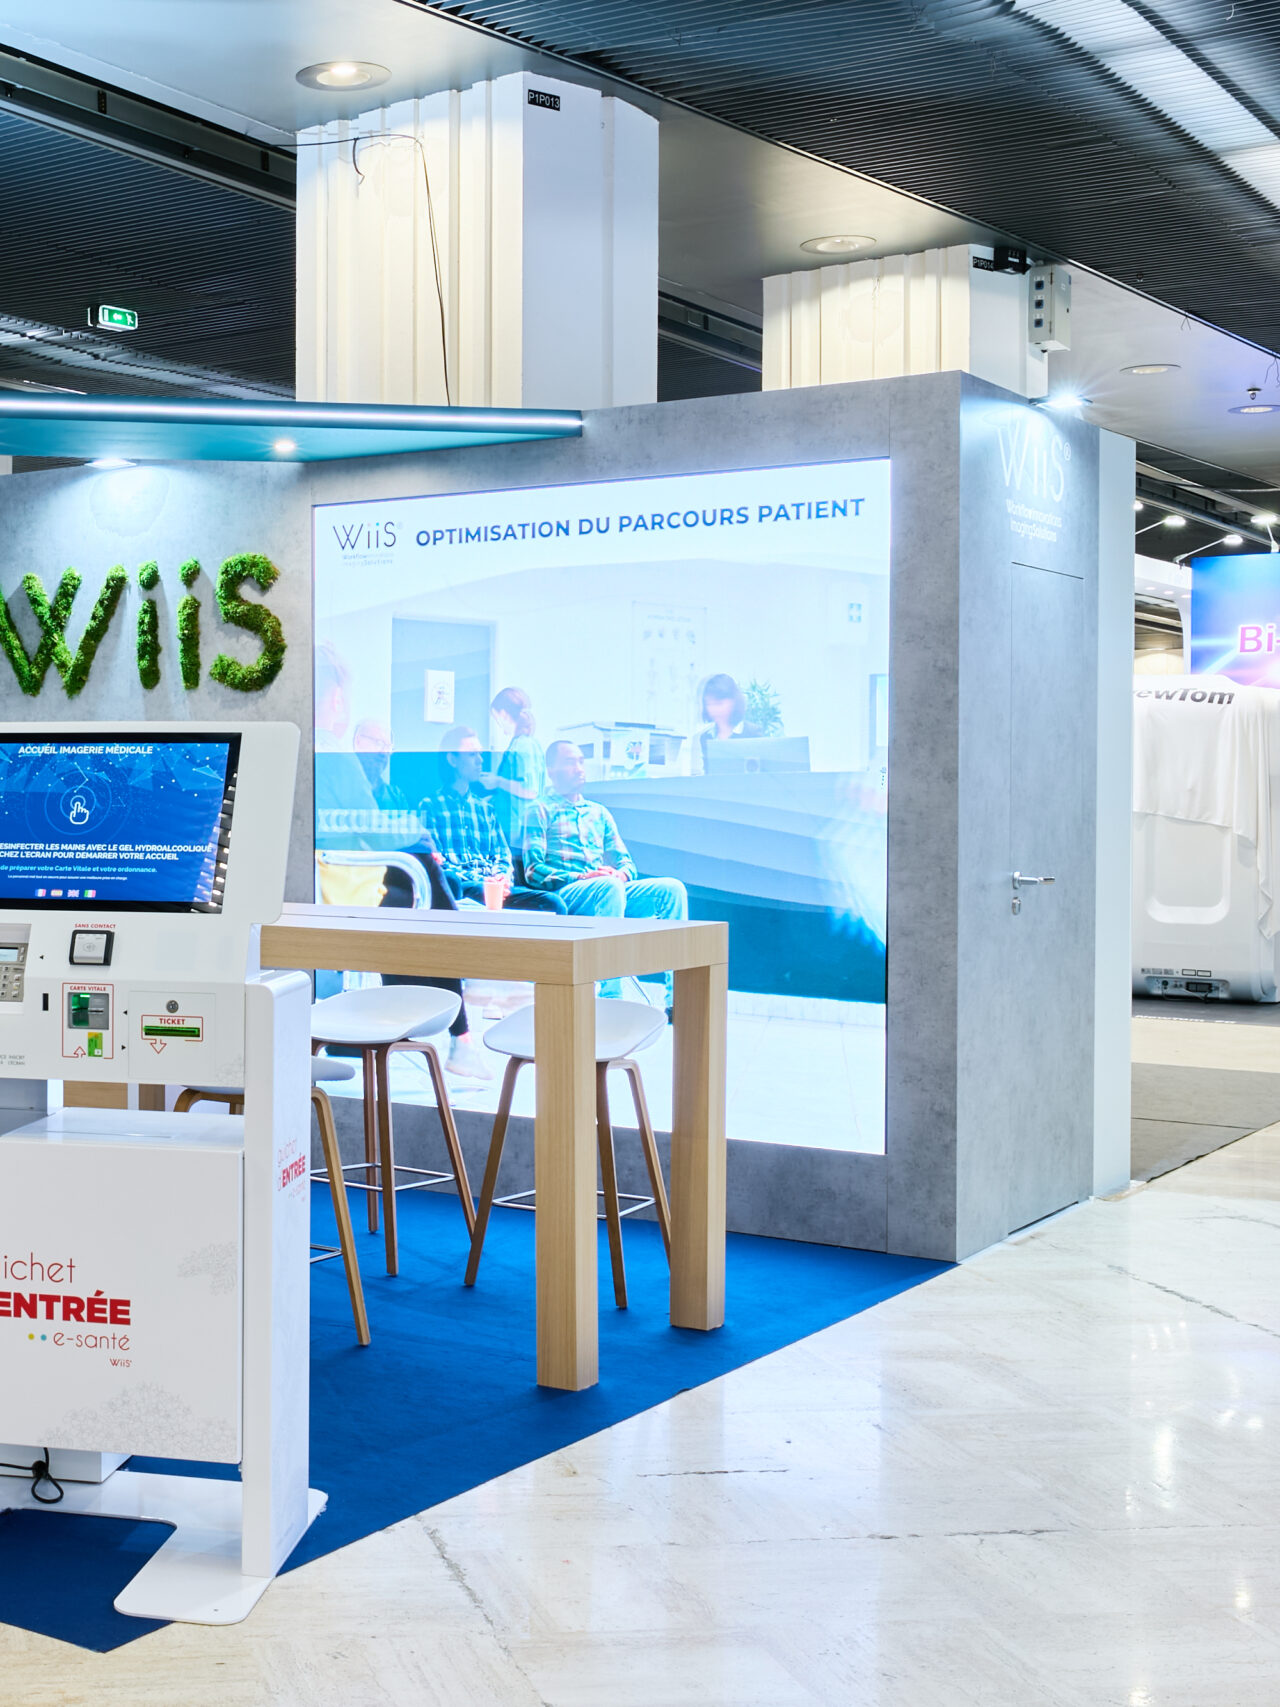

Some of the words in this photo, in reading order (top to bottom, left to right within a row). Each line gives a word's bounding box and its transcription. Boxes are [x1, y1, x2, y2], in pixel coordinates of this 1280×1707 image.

[528, 91, 560, 109] P1P013
[415, 520, 570, 547] OPTIMISATION
[578, 516, 611, 536] DU
[618, 506, 750, 534] PARCOURS
[757, 498, 867, 523] PATIENT
[1133, 687, 1235, 705] ewTom
[18, 745, 58, 755] ACCUEIL
[60, 746, 104, 755] IMAGERIE
[45, 843, 59, 851] LES
[119, 844, 133, 852] GEL
[135, 844, 213, 853] HYDROALCOOLIQUE
[53, 851, 74, 859] POUR
[75, 852, 118, 860] DEMARRER
[119, 852, 144, 860] VOTRE
[145, 853, 179, 861] ACCUEIL
[53, 1330, 130, 1351] e-santé
